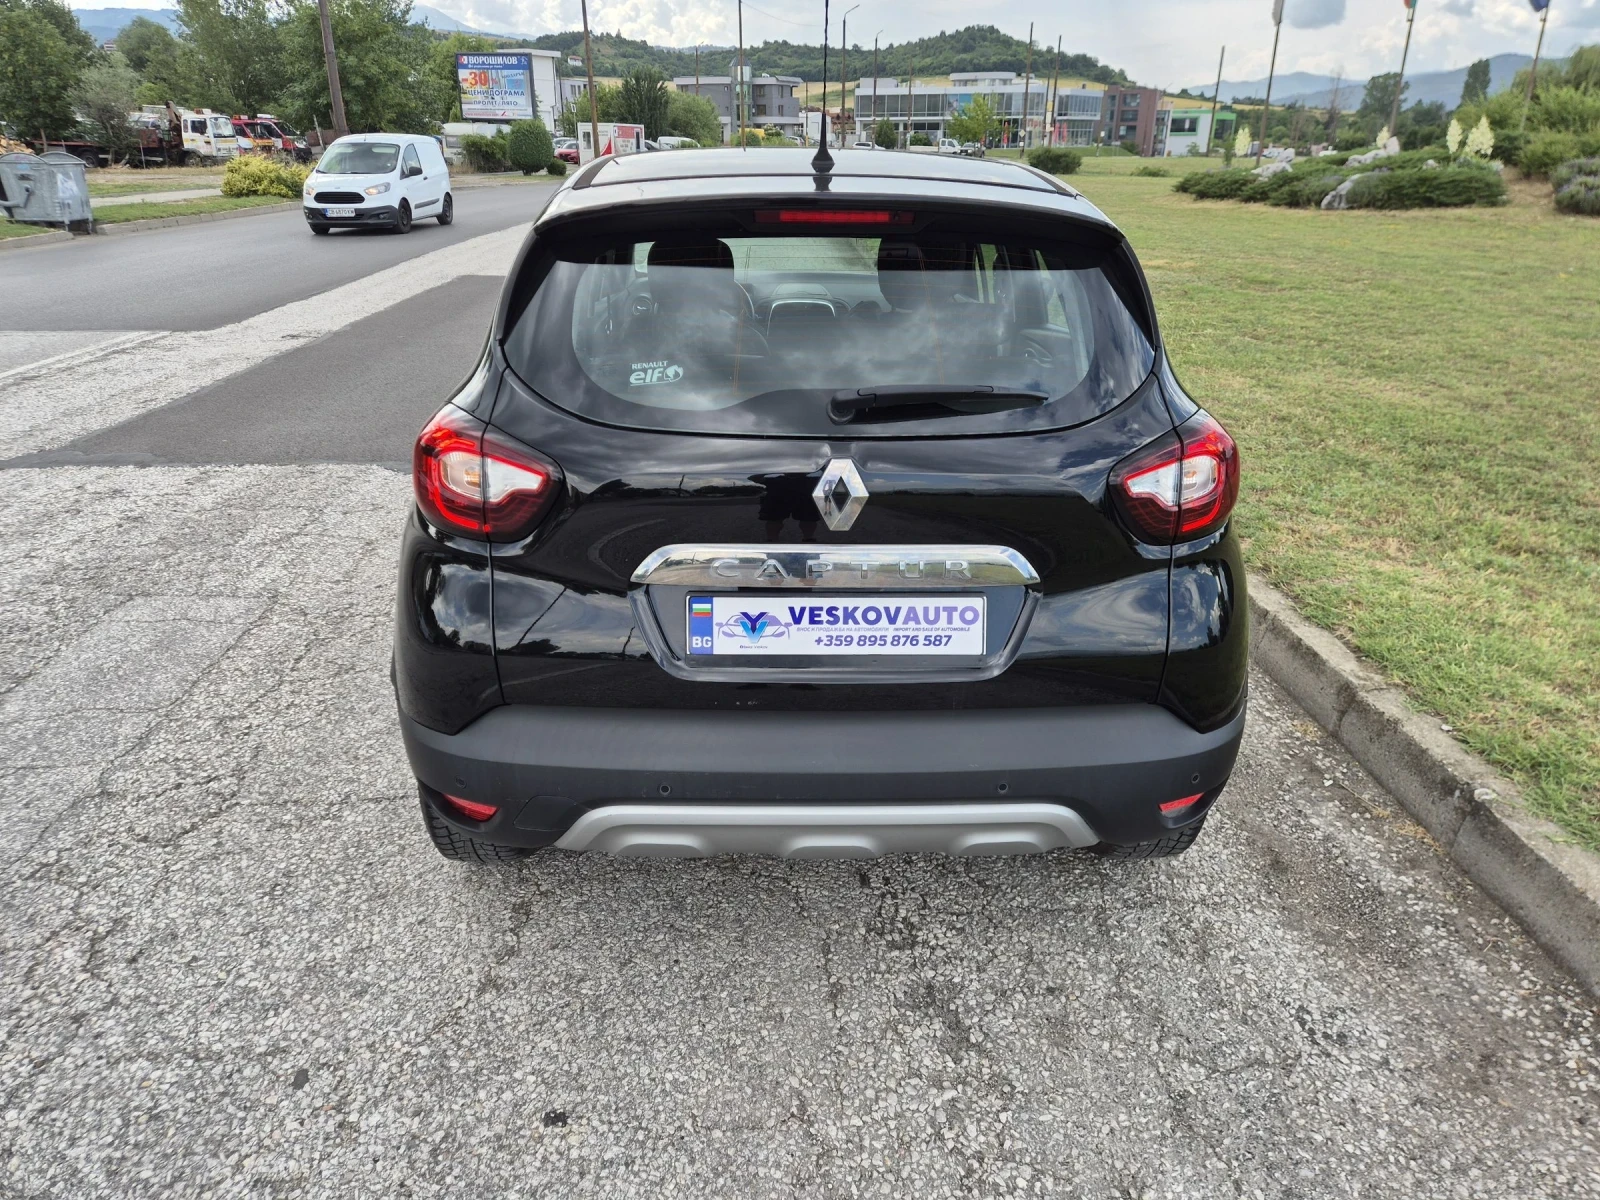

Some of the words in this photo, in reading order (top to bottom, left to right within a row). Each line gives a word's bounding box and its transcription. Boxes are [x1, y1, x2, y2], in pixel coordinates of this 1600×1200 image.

[468, 56, 518, 65] ВОРОШИЛОВ
[489, 89, 525, 97] ДОГРАМА
[631, 360, 668, 370] RENAULT
[630, 368, 664, 384] elf
[710, 558, 973, 580] CAPTUR
[788, 606, 980, 626] VESKOVAUTO
[692, 636, 712, 648] BG
[814, 634, 854, 646] +359
[856, 634, 888, 646] 895
[890, 634, 920, 646] 876
[922, 634, 952, 646] 587
